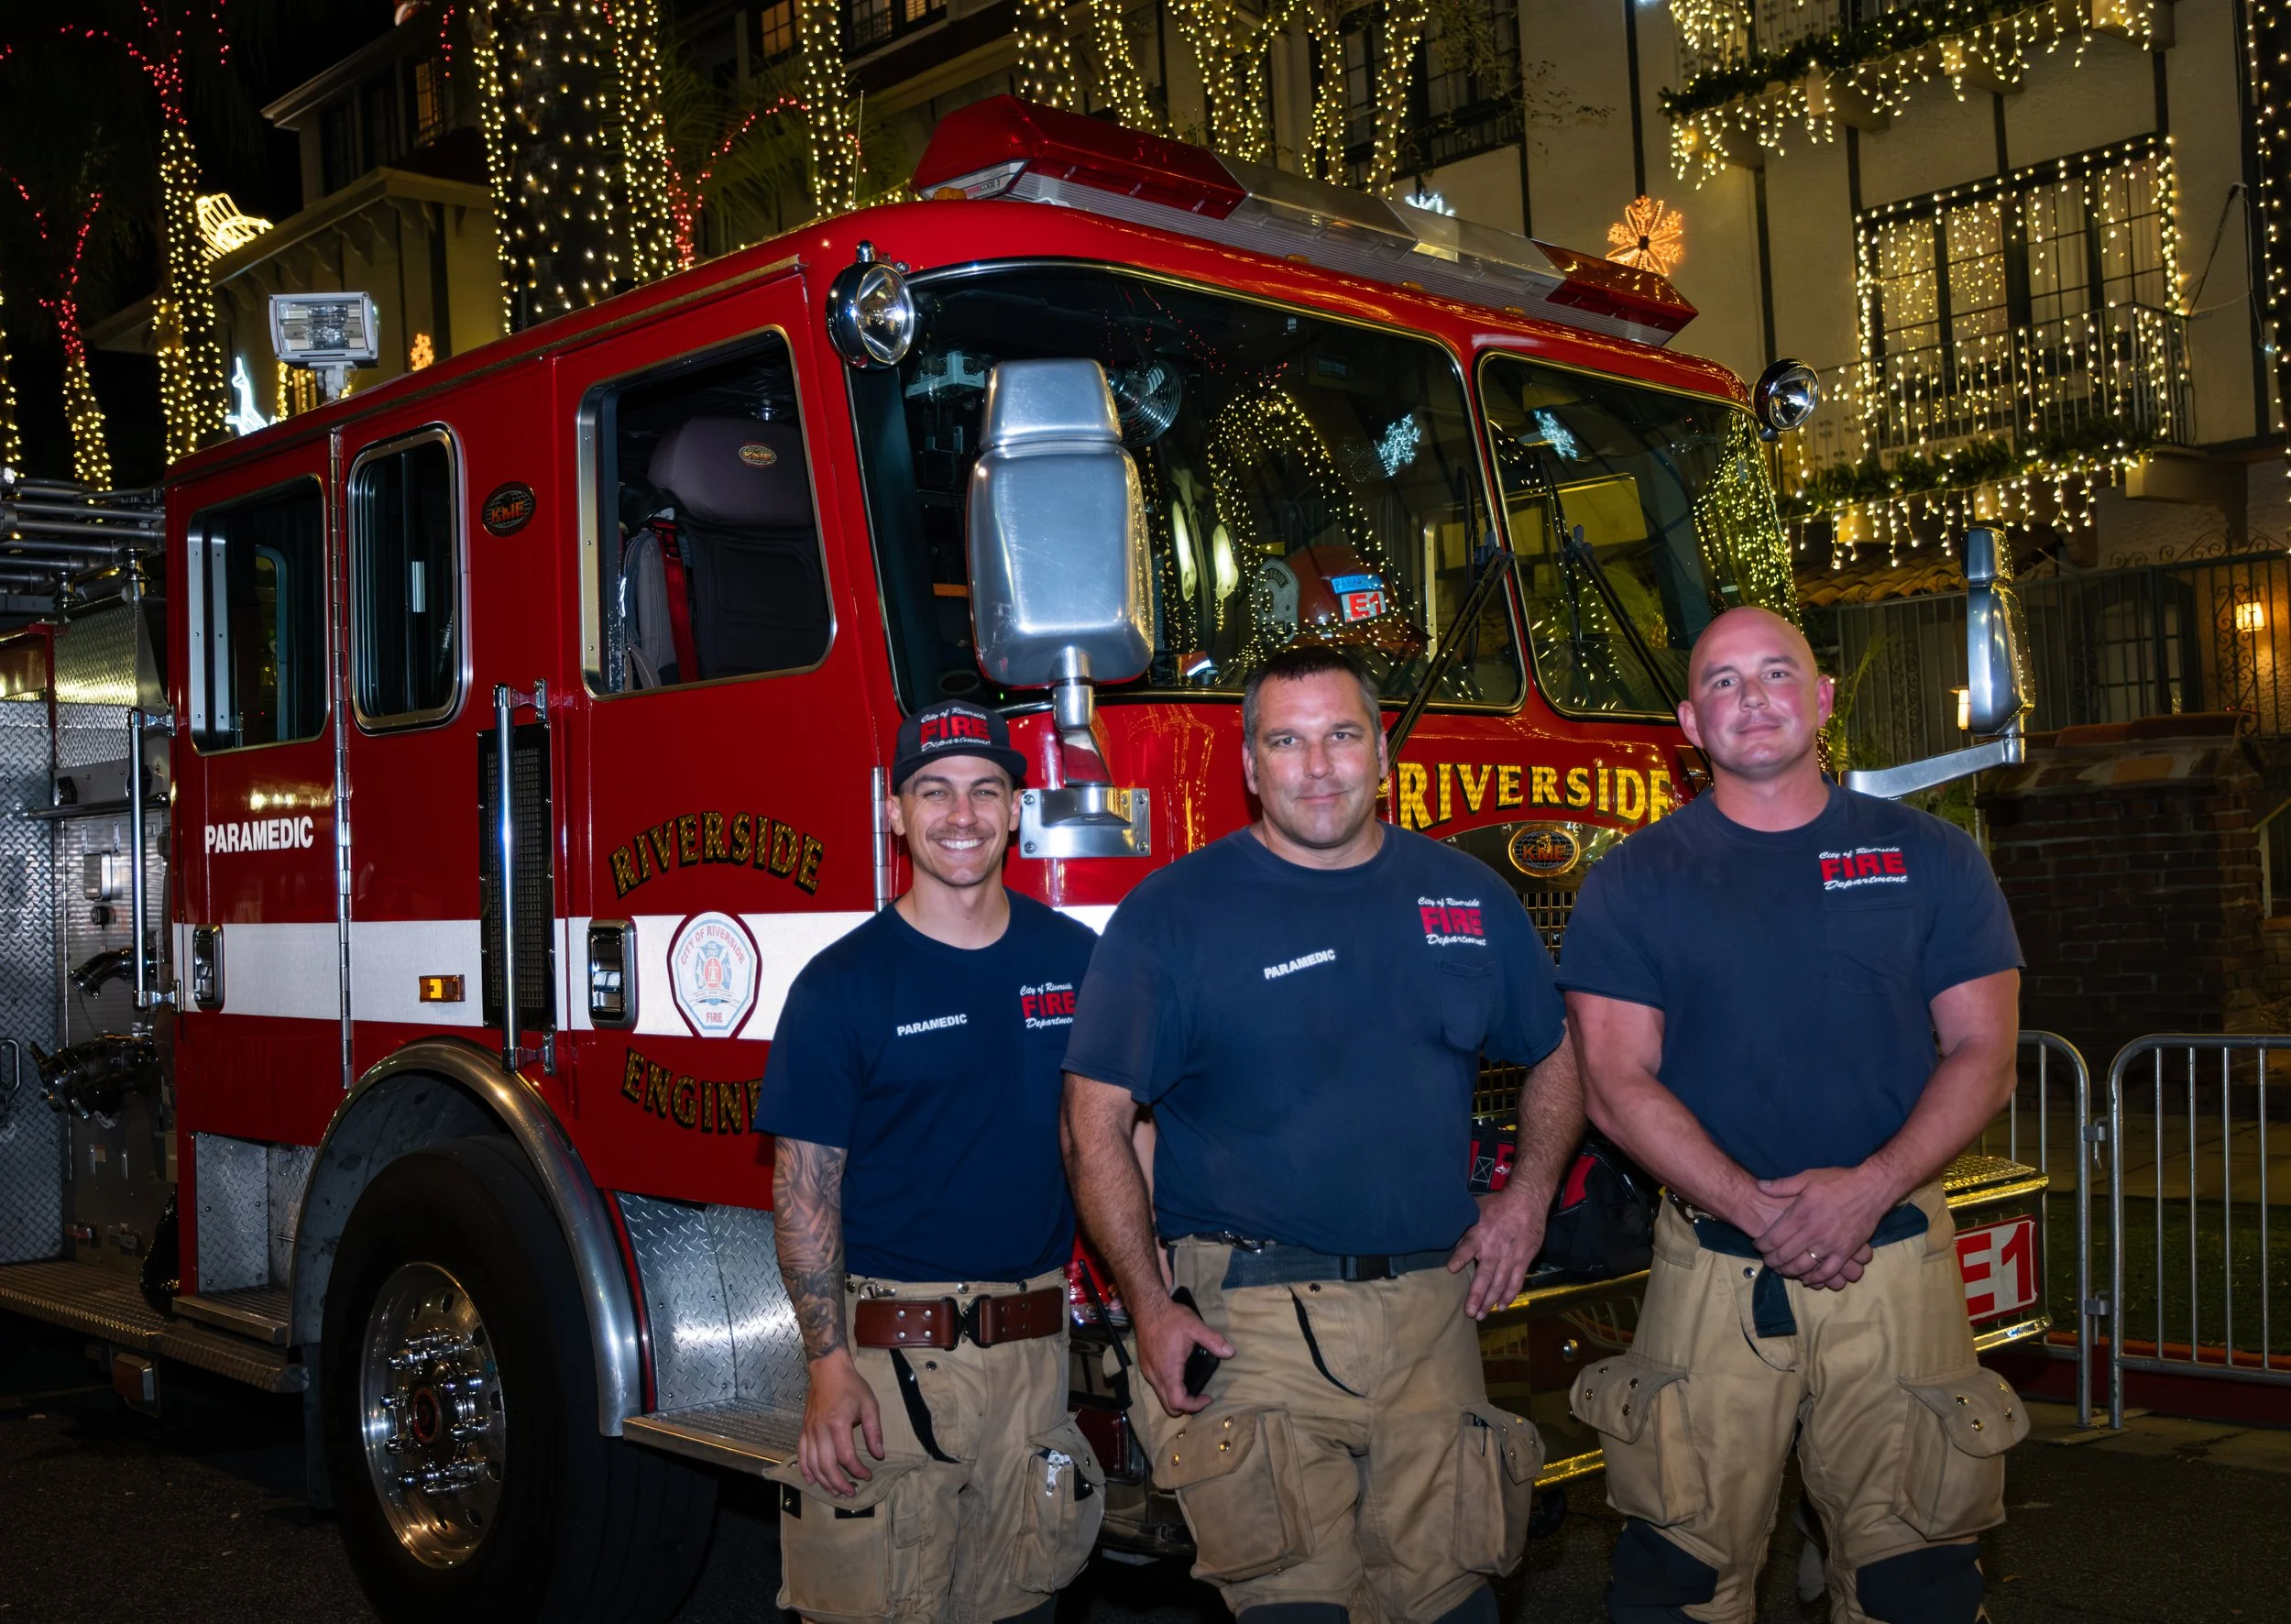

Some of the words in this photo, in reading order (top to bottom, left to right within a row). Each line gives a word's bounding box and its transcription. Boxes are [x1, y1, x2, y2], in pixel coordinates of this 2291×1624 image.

[491, 500, 525, 522] KME
[1348, 592, 1382, 618] E1
[921, 714, 938, 723] City
[939, 708, 949, 718] of
[920, 715, 991, 745] FIRE
[1395, 762, 1671, 832] RIVERSIDE
[204, 815, 314, 854] PARAMEDIC
[608, 811, 825, 901] RIVERSIDE
[1521, 843, 1567, 861] KME
[1820, 852, 1906, 882] FIRE
[1824, 875, 1907, 890] Department
[1418, 896, 1435, 906] City
[1436, 898, 1445, 907] of
[1445, 897, 1480, 907] Riverside
[1420, 905, 1485, 937] FIRE
[681, 939, 695, 964] CITY
[695, 928, 705, 942] OF
[707, 926, 745, 964] RIVERSIDE
[1263, 949, 1336, 980] PARAMEDIC
[1020, 985, 1036, 996] City
[1037, 984, 1045, 994] of
[706, 1011, 723, 1024] FIRE
[1021, 991, 1077, 1019] FIRE
[896, 1014, 968, 1037] PARAMEDIC
[1025, 1016, 1073, 1029] Departme
[1955, 1222, 2033, 1317] E1
